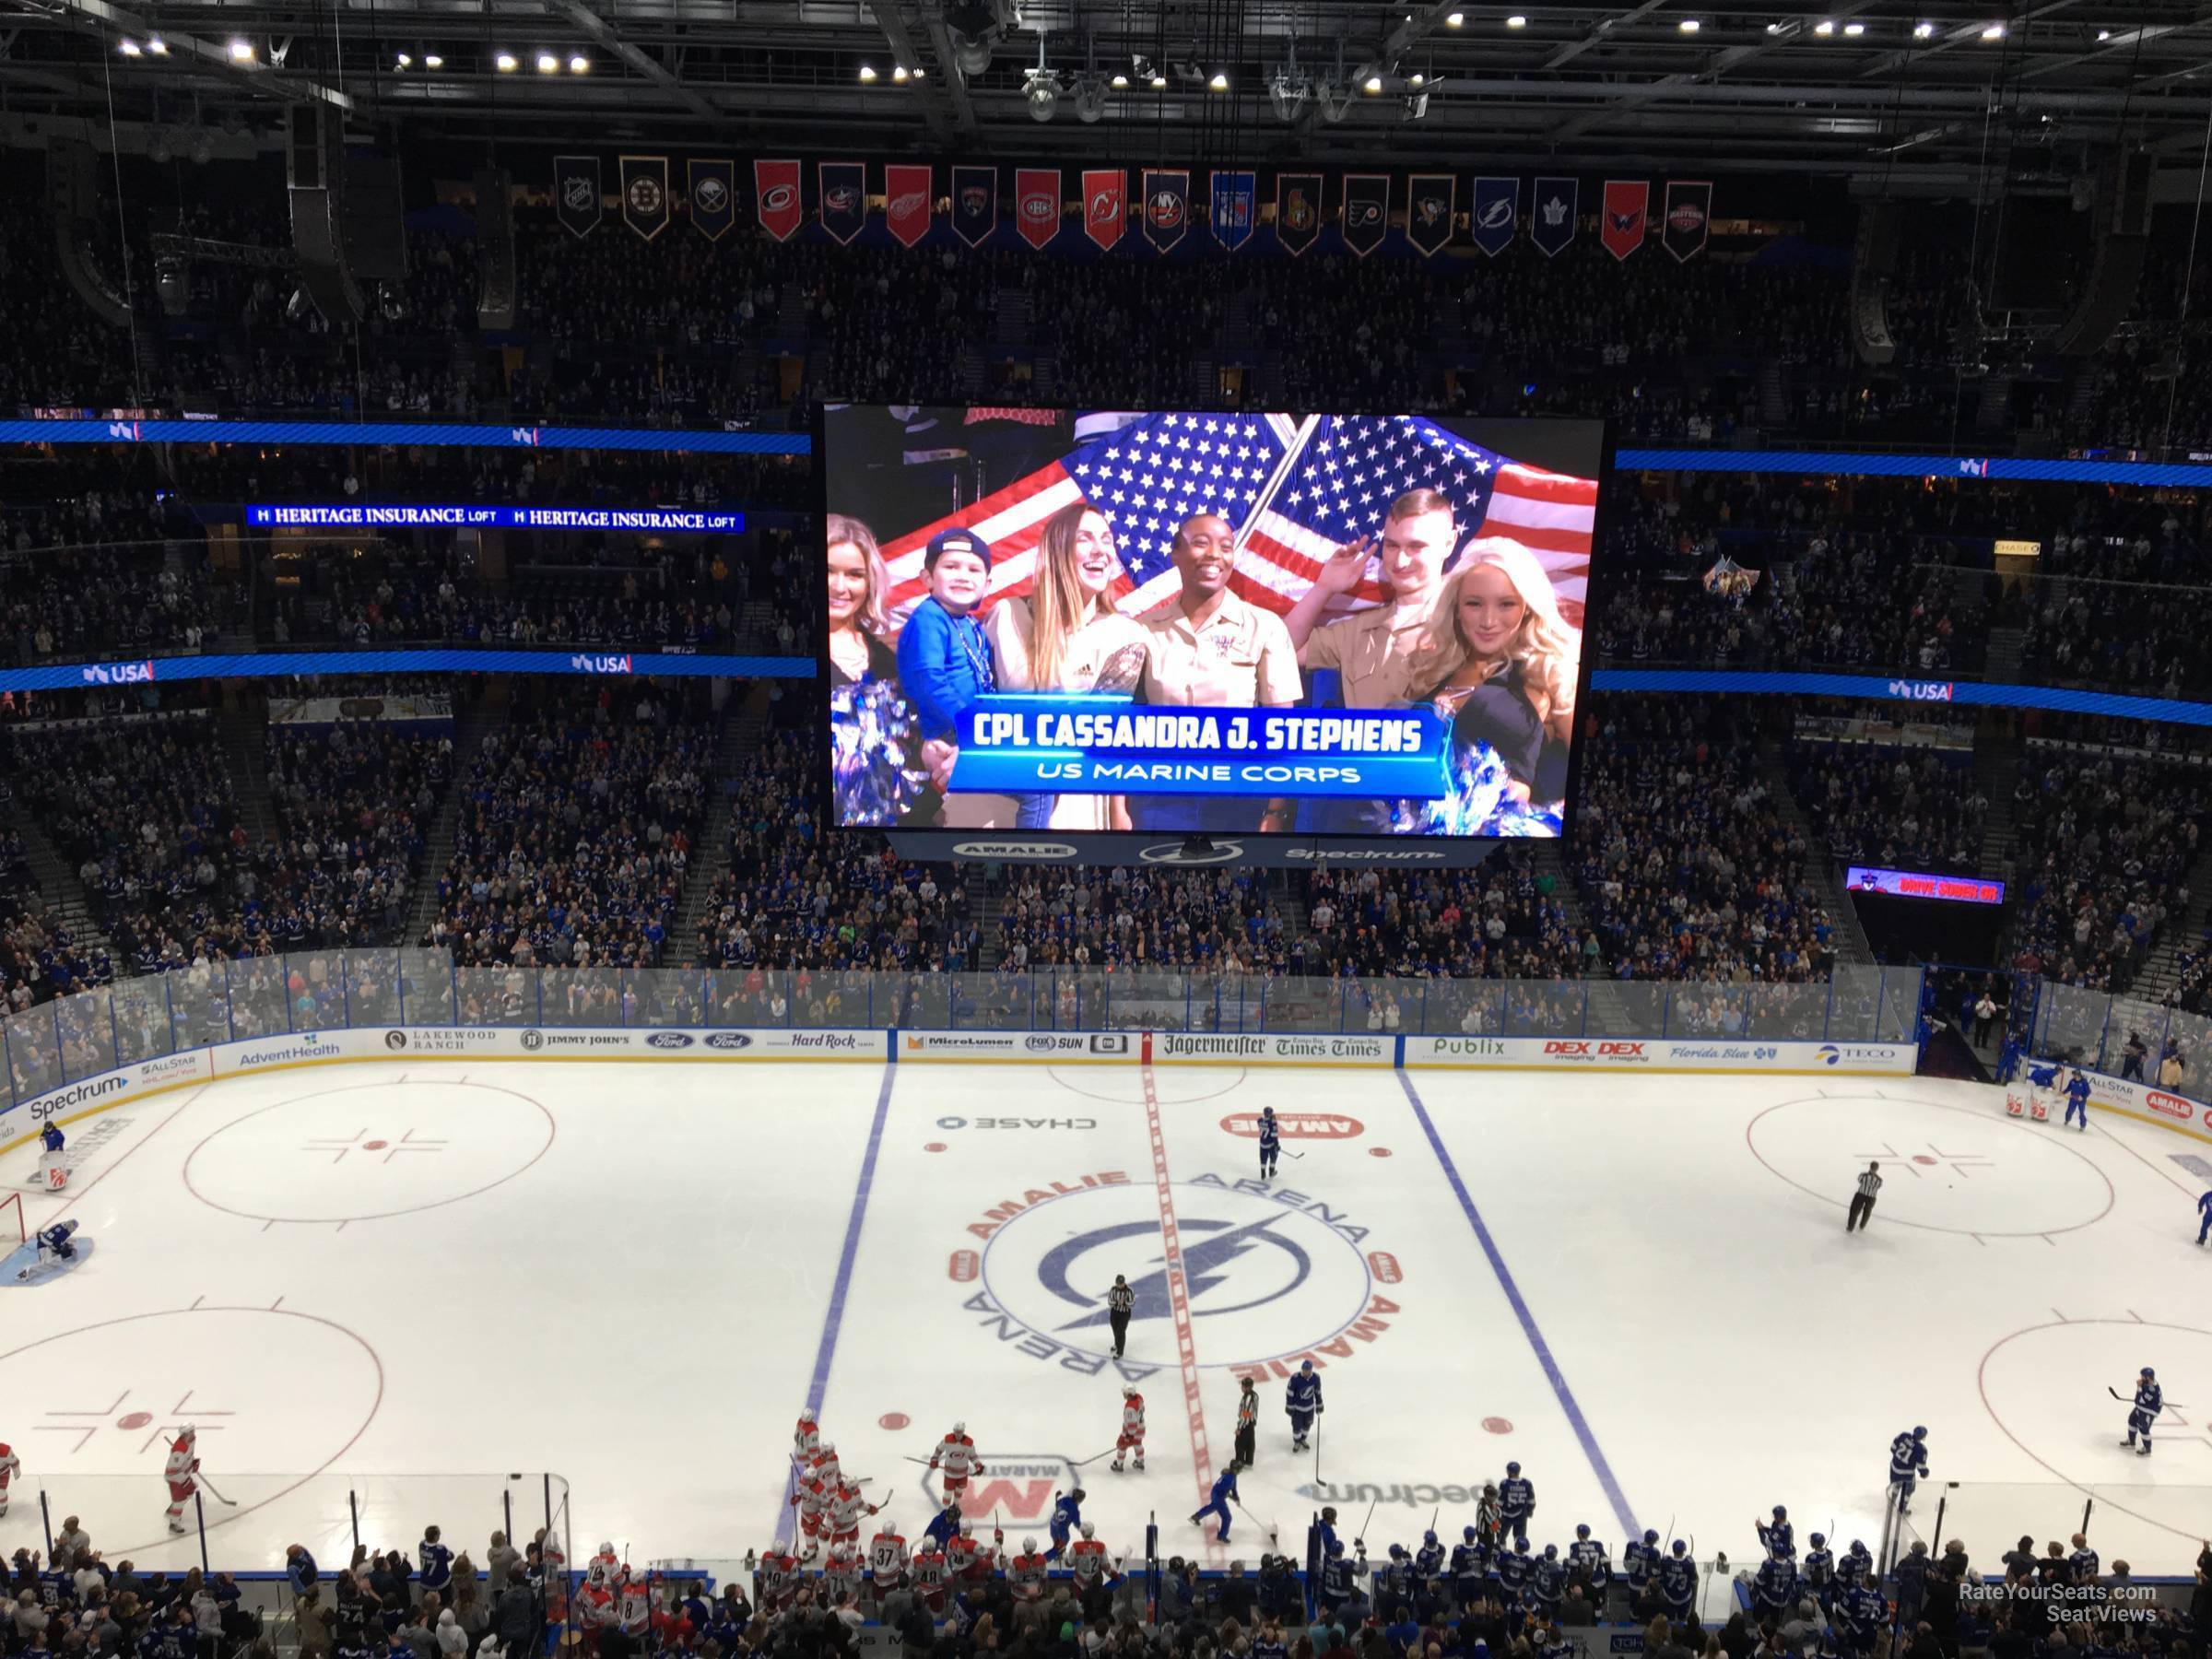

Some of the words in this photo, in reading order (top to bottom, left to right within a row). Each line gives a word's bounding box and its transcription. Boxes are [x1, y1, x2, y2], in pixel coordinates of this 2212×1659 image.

[275, 508, 362, 524] HERITAGE
[366, 508, 465, 524] INSURANCE
[468, 510, 496, 522] LOFT
[529, 510, 609, 526] HERITAGE
[612, 512, 705, 529] INSURANCE
[708, 516, 735, 528] LOFT
[595, 656, 629, 673] USA
[111, 665, 150, 683] USA
[1914, 683, 1948, 700] USA
[973, 712, 1030, 747] CPL
[1036, 713, 1221, 750] CASSANDRA
[1227, 717, 1257, 751] J.
[1265, 716, 1421, 753] STEPHENS
[1036, 762, 1083, 780] US
[1093, 763, 1231, 782] MARINE
[1241, 766, 1361, 783] CORPS
[963, 842, 1074, 856] AMALIE
[1285, 847, 1439, 865] Spectrum
[413, 1030, 496, 1041] LAKEWOOD
[547, 1035, 586, 1045] JIMMY
[589, 1035, 630, 1045] JOHN'S
[654, 1032, 686, 1047] Ford
[712, 1032, 743, 1048] Ford
[792, 1033, 824, 1047] Hard
[825, 1034, 856, 1049] Rock
[928, 1037, 1014, 1046] MicroLumen
[1031, 1037, 1050, 1047] FOX
[1058, 1038, 1083, 1049] SUN
[414, 1041, 465, 1050] RANCH
[1164, 1034, 1266, 1056] Jägermeister
[1276, 1039, 1326, 1056] Times
[1332, 1040, 1382, 1057] Times
[1433, 1038, 1504, 1055] Publix
[1544, 1041, 1591, 1054] DEX
[1597, 1042, 1645, 1055] DEX
[1669, 1047, 1719, 1059] Florida
[1721, 1048, 1750, 1060] Blue
[240, 1042, 340, 1066] AdventHealth
[1843, 1049, 1896, 1059] TECO
[30, 1076, 123, 1121] Spectrum
[2148, 1095, 2192, 1116] AMALIE
[975, 1117, 1098, 1130] CHASE
[1229, 1118, 1352, 1134] AMAIE
[966, 1171, 1132, 1240] AMALIE
[1189, 1172, 1371, 1244] ARENA
[962, 1290, 1162, 1382] ARENA
[1895, 1445, 1914, 1465] 21
[877, 1548, 894, 1567] 37
[1668, 1573, 1688, 1591] 73
